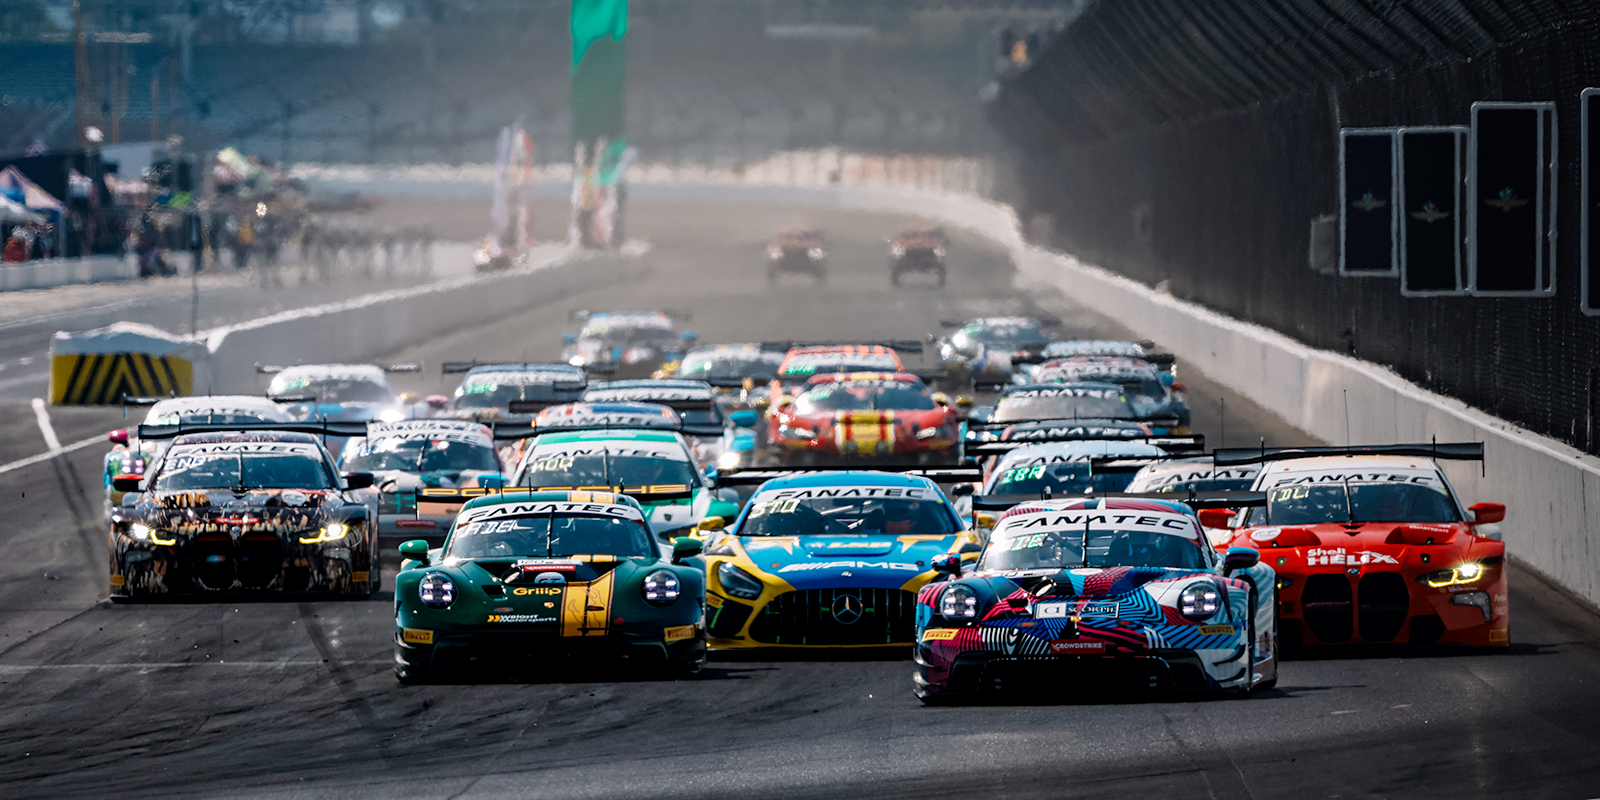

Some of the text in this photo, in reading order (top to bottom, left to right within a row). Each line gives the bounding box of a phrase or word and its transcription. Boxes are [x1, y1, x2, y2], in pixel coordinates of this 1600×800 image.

[172, 445, 309, 457] FANATEC
[534, 448, 673, 461] FANATEC
[1145, 470, 1256, 490] FANAT
[1274, 473, 1433, 487] FANATEC
[775, 487, 923, 500] FANATEC
[467, 504, 629, 522] FANATEC
[1004, 515, 1188, 531] FANATEC
[1308, 547, 1346, 557] Shell
[1308, 551, 1399, 566] HELIX
[827, 561, 919, 571] AMG
[1055, 642, 1103, 650] CROWDSTRIKE
